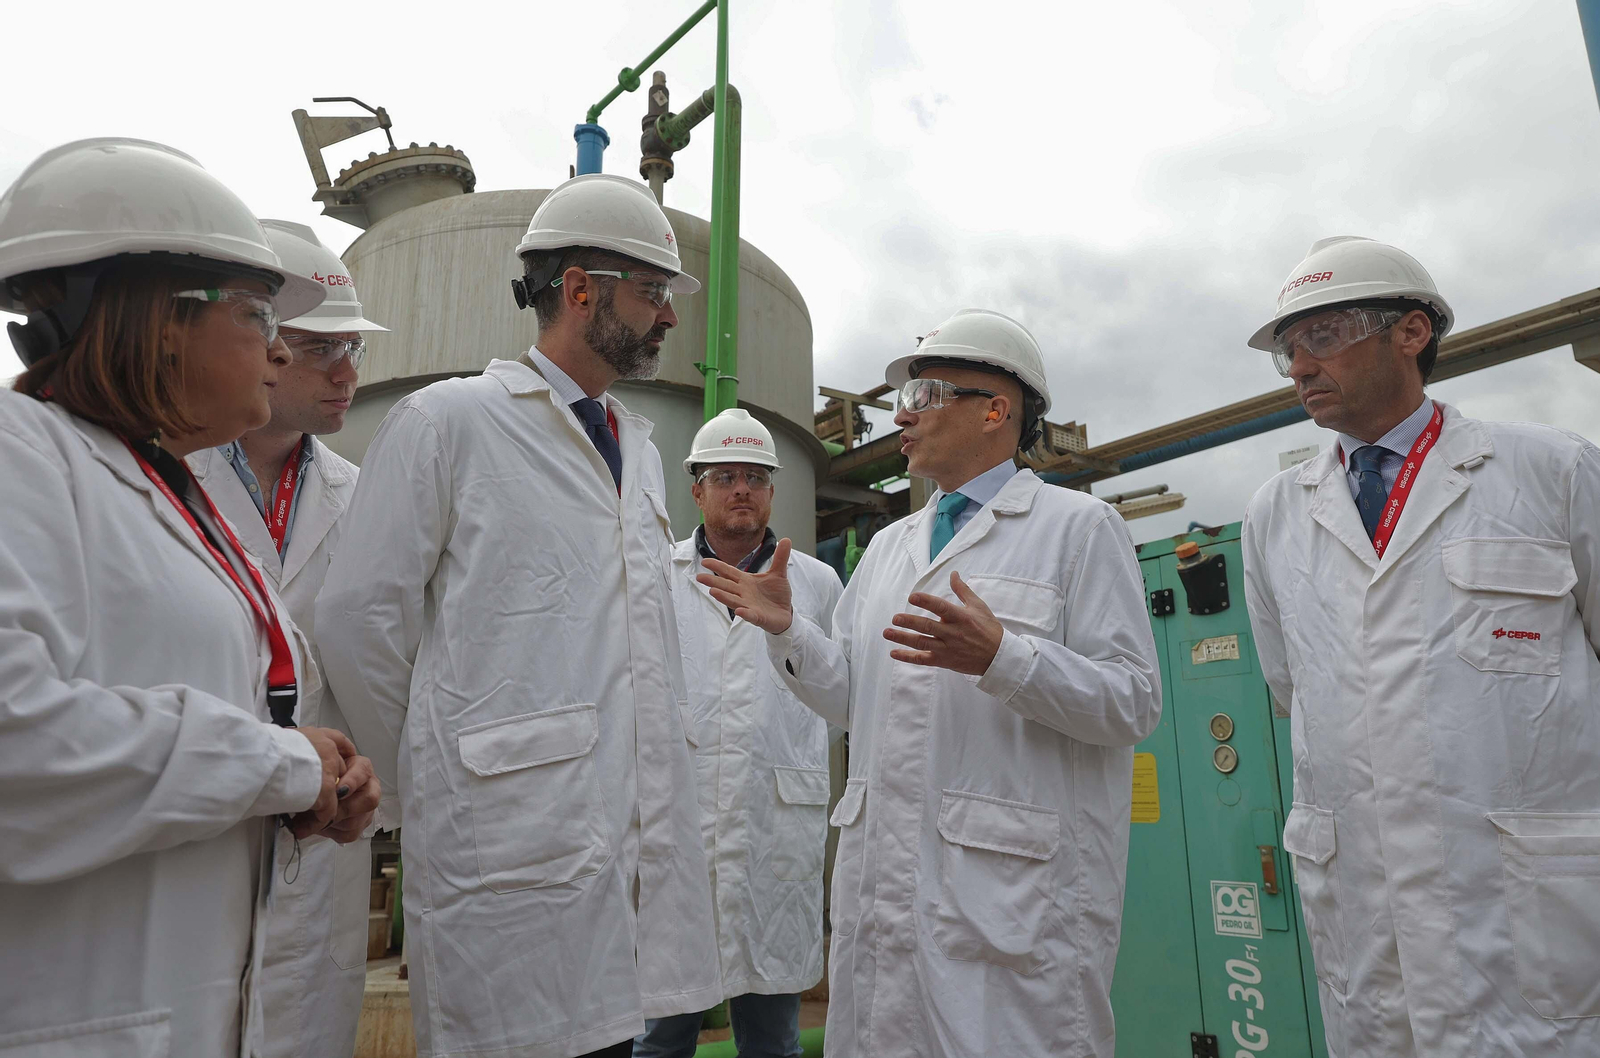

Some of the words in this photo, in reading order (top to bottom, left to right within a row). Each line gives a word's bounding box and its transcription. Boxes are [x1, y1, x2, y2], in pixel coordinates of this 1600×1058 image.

[1287, 271, 1333, 292] CEPSA
[735, 437, 764, 446] CEPSA
[1399, 469, 1412, 489] CEPSA
[278, 499, 287, 519] CEPSA
[1383, 506, 1396, 528] CEPSA
[1507, 630, 1541, 641] CEPSA
[1221, 919, 1242, 929] PEDRO
[1243, 921, 1254, 930] GIL
[1244, 943, 1259, 962] F1
